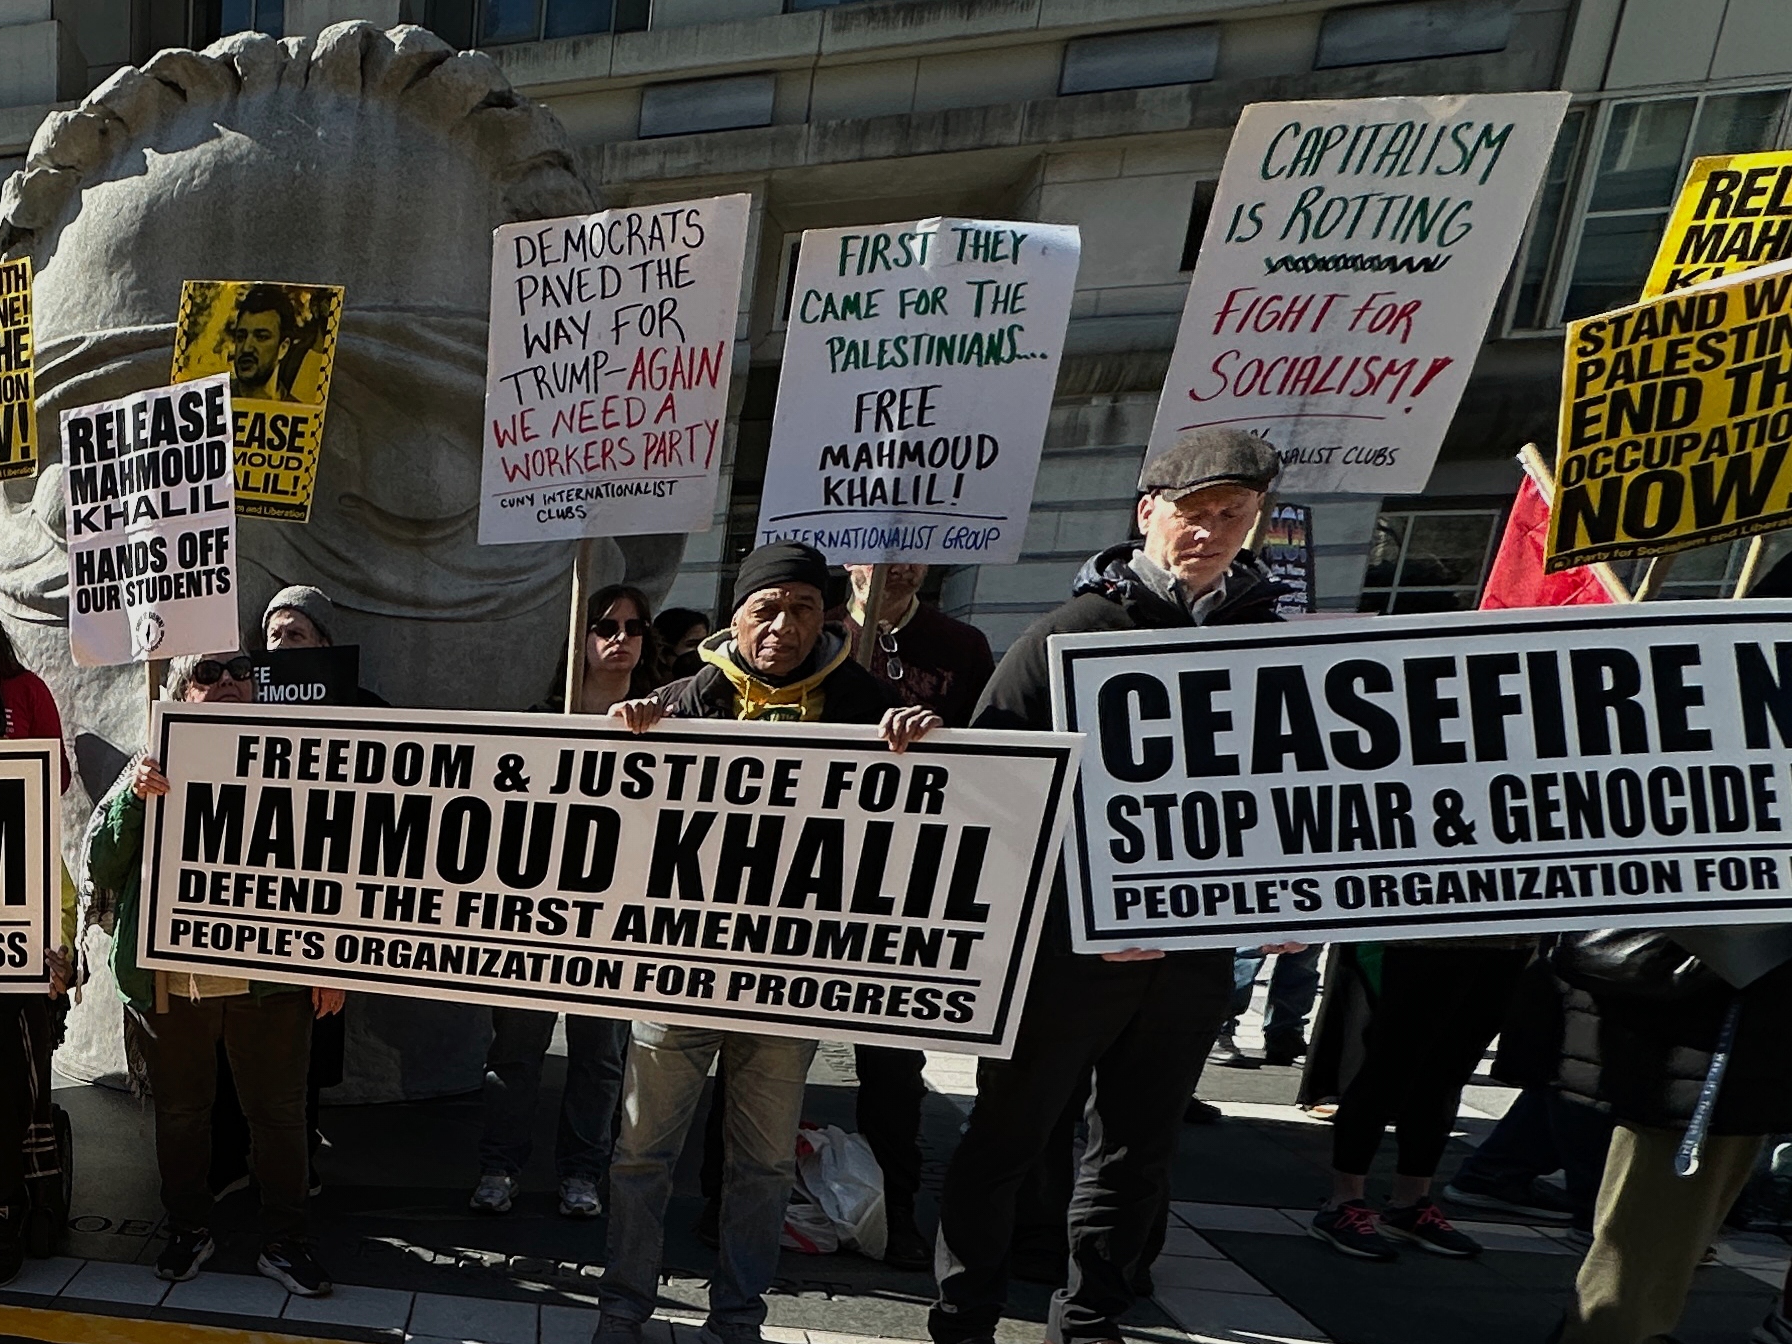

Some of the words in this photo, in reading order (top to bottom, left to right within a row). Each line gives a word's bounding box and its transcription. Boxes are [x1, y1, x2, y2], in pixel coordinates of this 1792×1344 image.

[1260, 119, 1515, 186] CAPITALISM
[514, 208, 705, 268] DEMOCRATS
[1224, 201, 1266, 245] IS
[1278, 184, 1474, 248] ROTTING
[838, 231, 937, 277] FIRST
[951, 227, 1029, 265] THEY
[515, 265, 622, 316] PAVED
[628, 253, 696, 293] THE
[800, 288, 885, 324] CAME
[899, 285, 948, 319] FOR
[966, 278, 1029, 318] THE
[1212, 286, 1351, 336] FIGHT
[1348, 291, 1422, 344] FOR
[523, 309, 591, 359] WAY
[610, 297, 686, 346] FOR
[1576, 290, 1729, 358] STAND
[1188, 349, 1454, 414] SOCIALISM!
[1574, 313, 1792, 400] PALESTIN
[67, 384, 228, 467] RELEASE
[232, 410, 310, 454] EASE
[493, 407, 539, 449] WE
[552, 395, 647, 439] NEED
[654, 392, 676, 424] A
[854, 383, 943, 433] FREE
[1568, 377, 1704, 453] END
[1725, 353, 1792, 418] TH
[69, 439, 228, 507] MAHMOUD
[233, 451, 303, 471] MOUD
[501, 437, 636, 483] WORKERS
[643, 418, 720, 470] PARTY
[818, 433, 999, 472] MAHMOUD
[1342, 446, 1402, 466] CLUBS
[1561, 407, 1792, 489] OCCUPATIO
[72, 483, 229, 536] KHALIL
[500, 494, 535, 509] CUNY
[543, 479, 679, 506] INTERNATIONALIST
[536, 505, 588, 524] CLUBS
[823, 472, 965, 507] KHALIL!
[1555, 440, 1792, 554] NOW
[75, 535, 168, 587] HANDS
[177, 526, 230, 570] OFF
[942, 526, 1001, 551] GROUP
[76, 583, 122, 615] OUR
[125, 566, 231, 607] STUDENTS
[257, 683, 326, 702] HMOUD
[1098, 643, 1714, 783] CEASEFIRE
[236, 735, 476, 790] FREEDOM
[493, 753, 531, 794] &
[549, 749, 804, 807] JUSTICE
[821, 761, 950, 815] FOR
[1107, 790, 1258, 864] STOP
[1270, 781, 1417, 855] WAR
[1432, 788, 1478, 848] &
[1489, 764, 1782, 845] GENOCIDE
[181, 781, 621, 893] MAHMOUD
[646, 808, 992, 924] KHALIL
[178, 868, 343, 916] DEFEND
[355, 882, 445, 926] THE
[455, 890, 605, 939] FIRST
[611, 903, 985, 972] AMENDMENT
[1113, 877, 1323, 921] PEOPLE'S
[1334, 859, 1683, 910] ORGANIZATION
[1694, 857, 1780, 893] FOR
[169, 918, 326, 961] PEOPLE'S
[334, 933, 623, 990] ORGANIZATION
[633, 962, 716, 999] FOR
[726, 970, 977, 1024] PROGRESS
